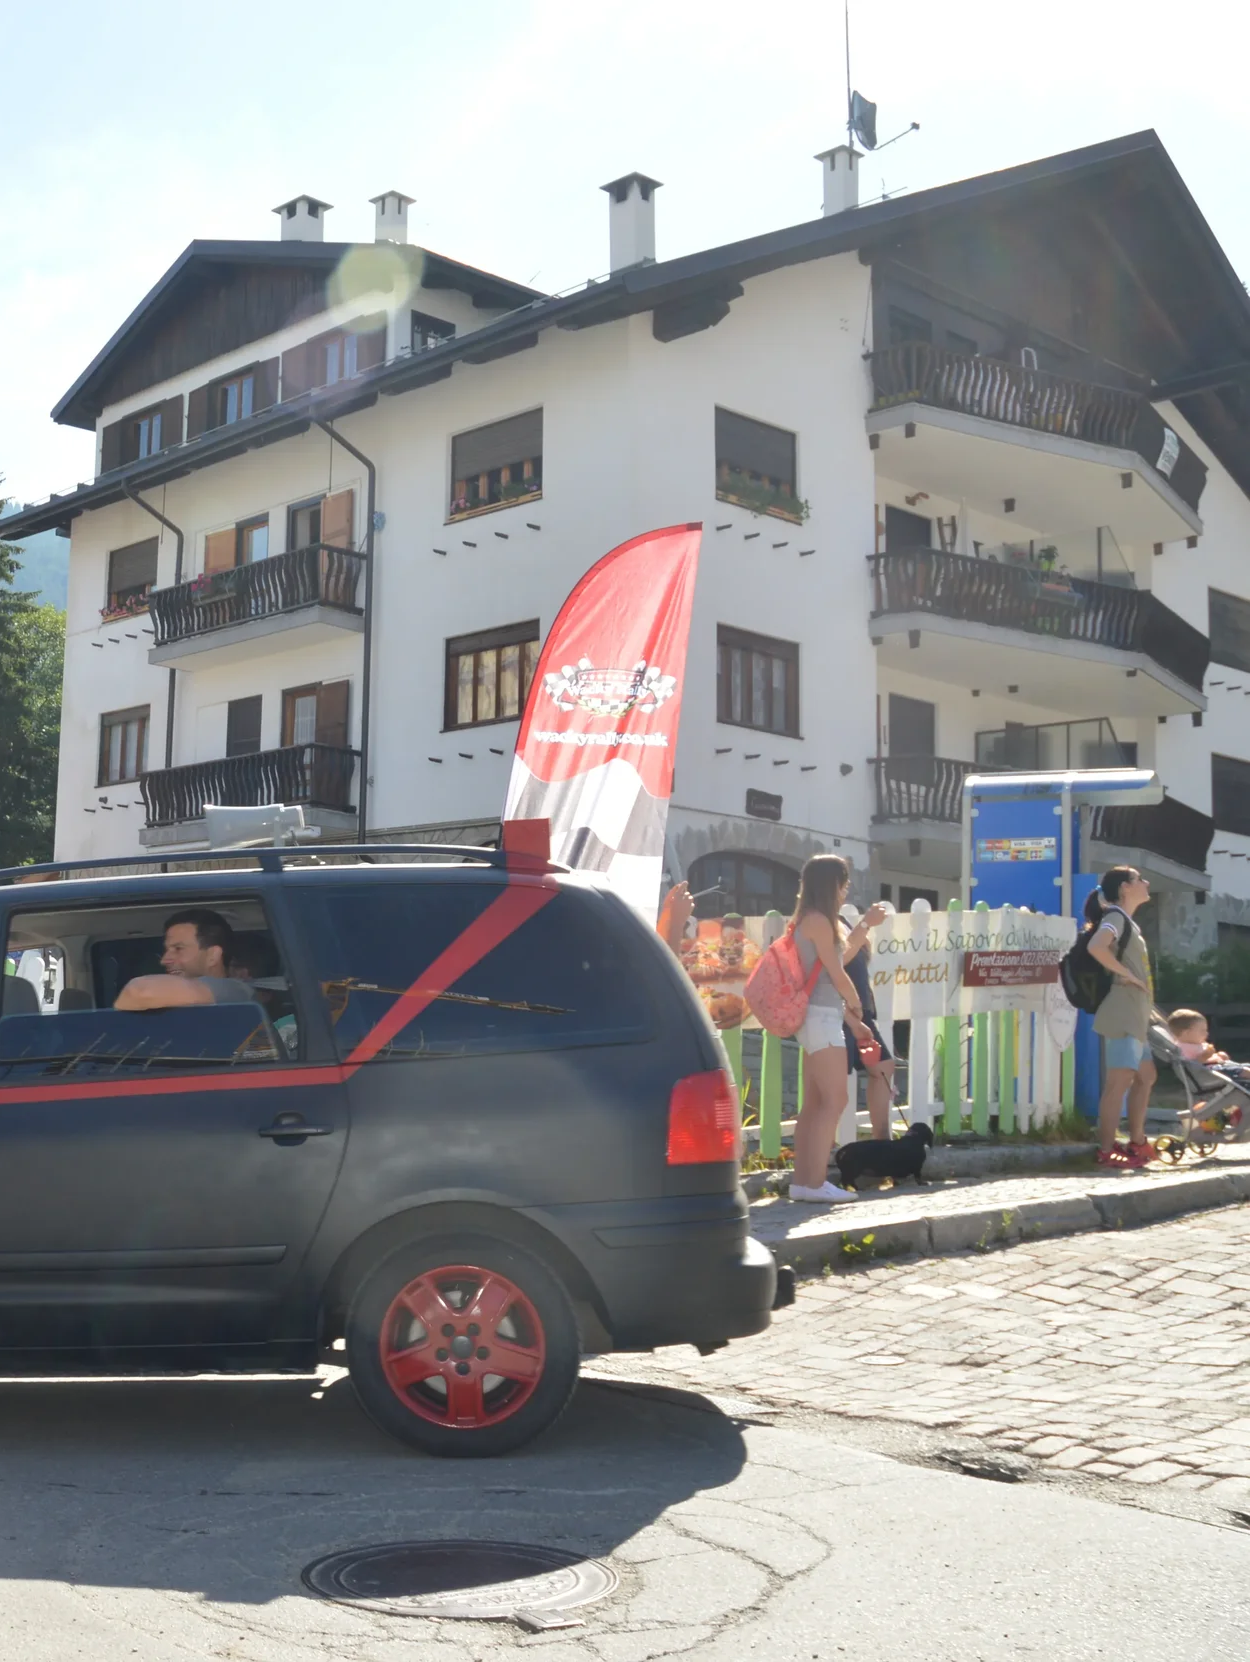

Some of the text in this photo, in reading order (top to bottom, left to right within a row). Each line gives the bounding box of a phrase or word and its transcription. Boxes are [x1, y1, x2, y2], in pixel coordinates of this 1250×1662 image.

[533, 729, 669, 747] wackyrally.co.uk
[877, 937, 922, 955] con
[926, 928, 943, 951] il
[873, 962, 949, 986] a tutti!
